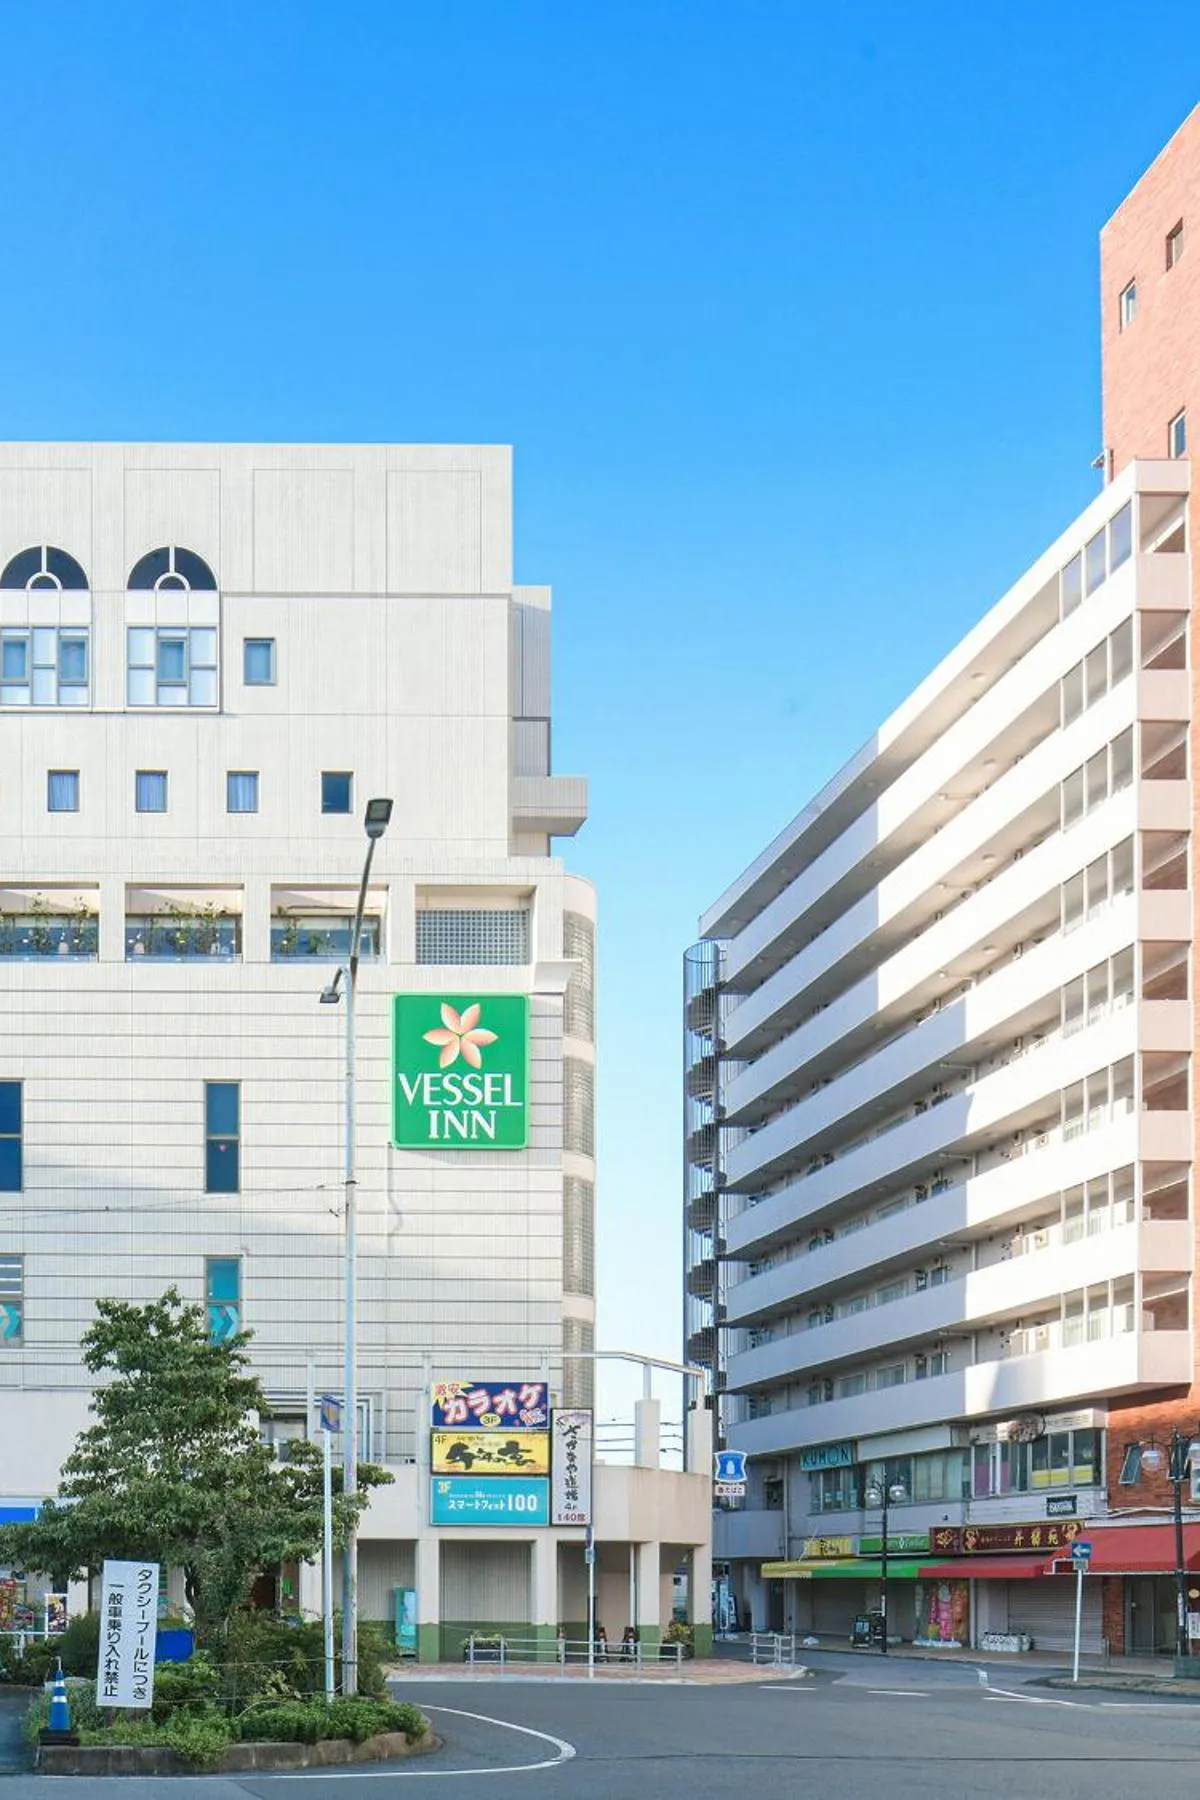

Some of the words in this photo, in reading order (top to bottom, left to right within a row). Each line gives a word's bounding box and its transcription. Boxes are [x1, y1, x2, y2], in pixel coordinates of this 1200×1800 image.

[398, 1072, 523, 1106] VESSEL
[428, 1110, 497, 1140] INN
[443, 1384, 543, 1424] カラオケ
[482, 1416, 497, 1424] 3F
[434, 1435, 447, 1444] 4F
[802, 1446, 850, 1468] KUMON
[438, 1480, 452, 1495] 3F
[103, 1583, 125, 1697] 一般車乗り入れ禁止
